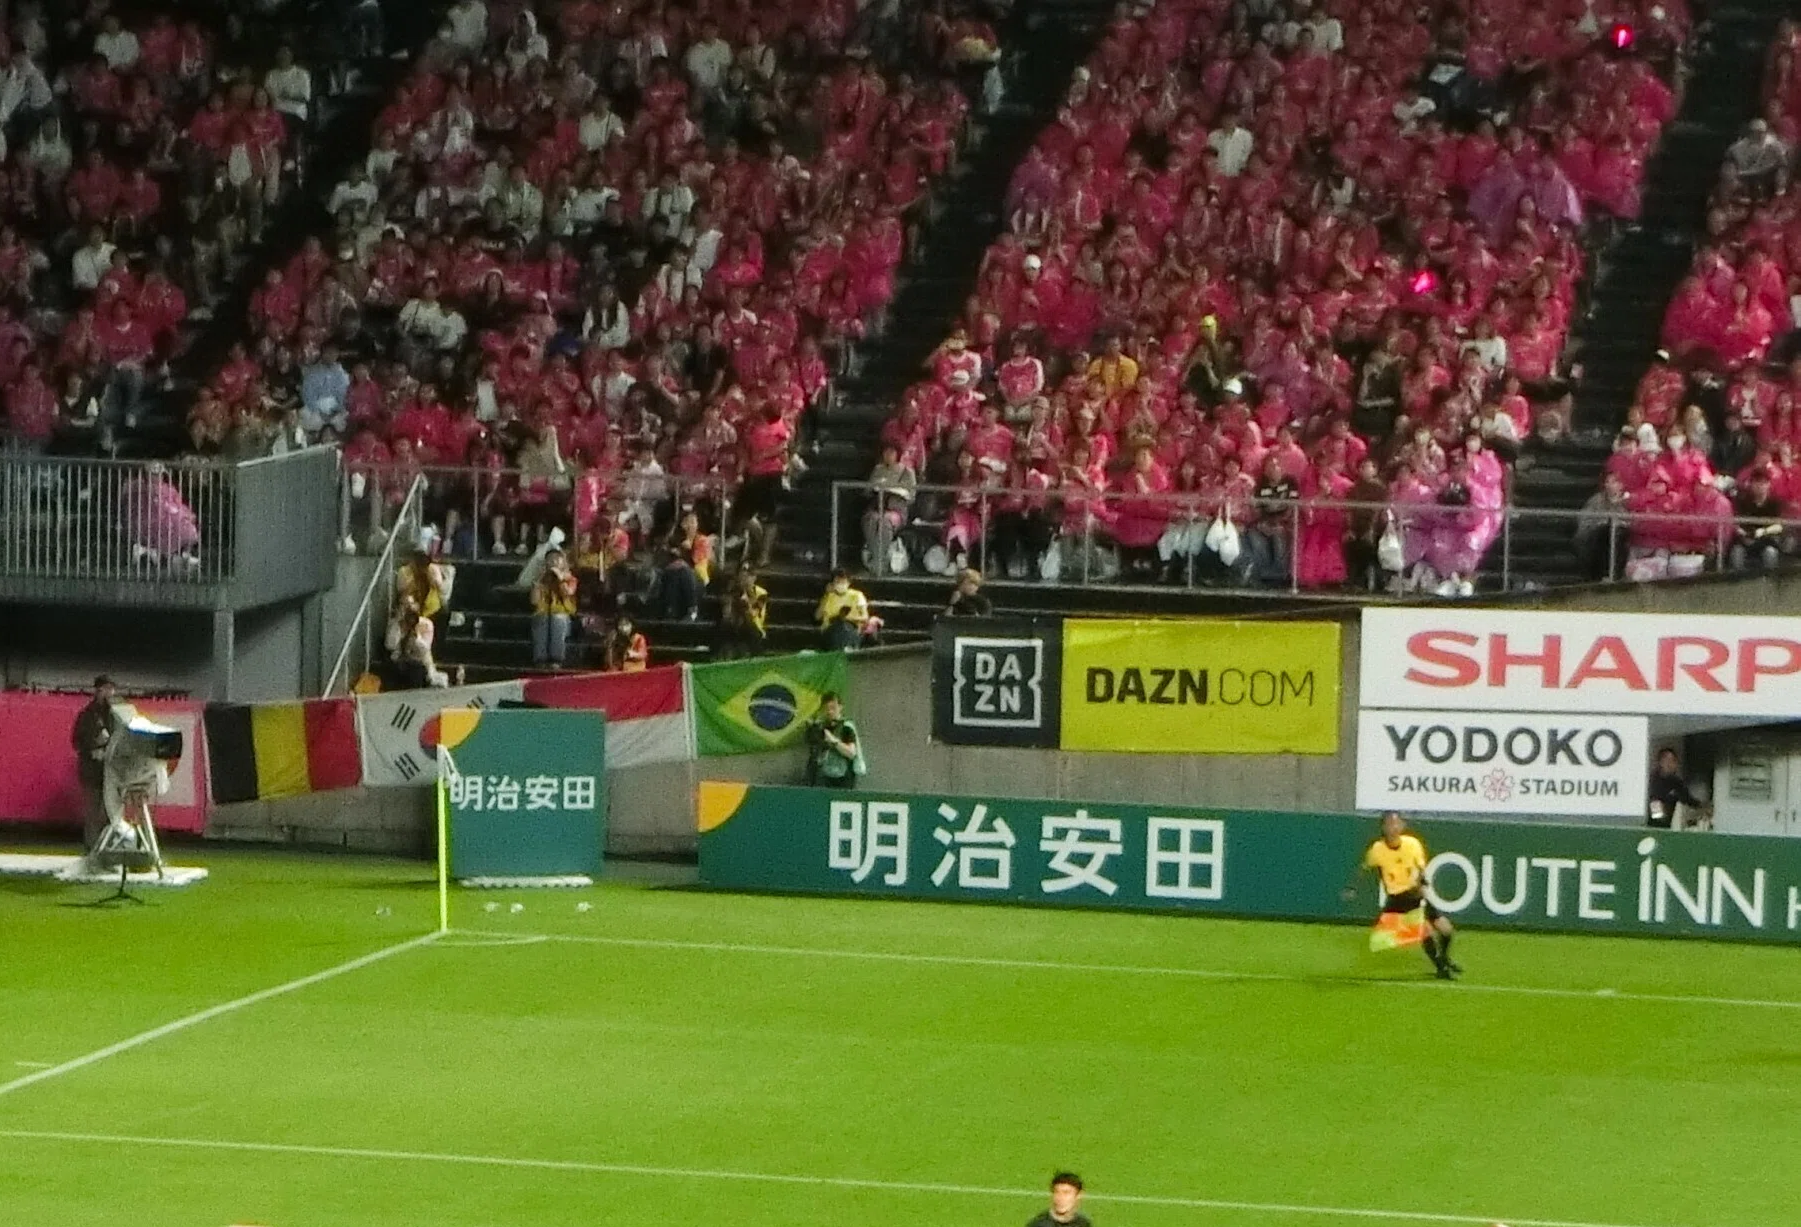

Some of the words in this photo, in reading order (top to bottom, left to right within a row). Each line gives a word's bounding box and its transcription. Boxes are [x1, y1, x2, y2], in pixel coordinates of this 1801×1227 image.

[1403, 629, 1801, 693] SHARP
[1086, 667, 1314, 707] DAZN.COM
[1383, 724, 1623, 767] YODOKO
[451, 775, 596, 812] 明治安田
[1388, 774, 1477, 794] SAKURA
[1519, 777, 1619, 797] STADIUM
[829, 801, 1225, 900] 明治安田
[1379, 851, 1616, 919] OUTE
